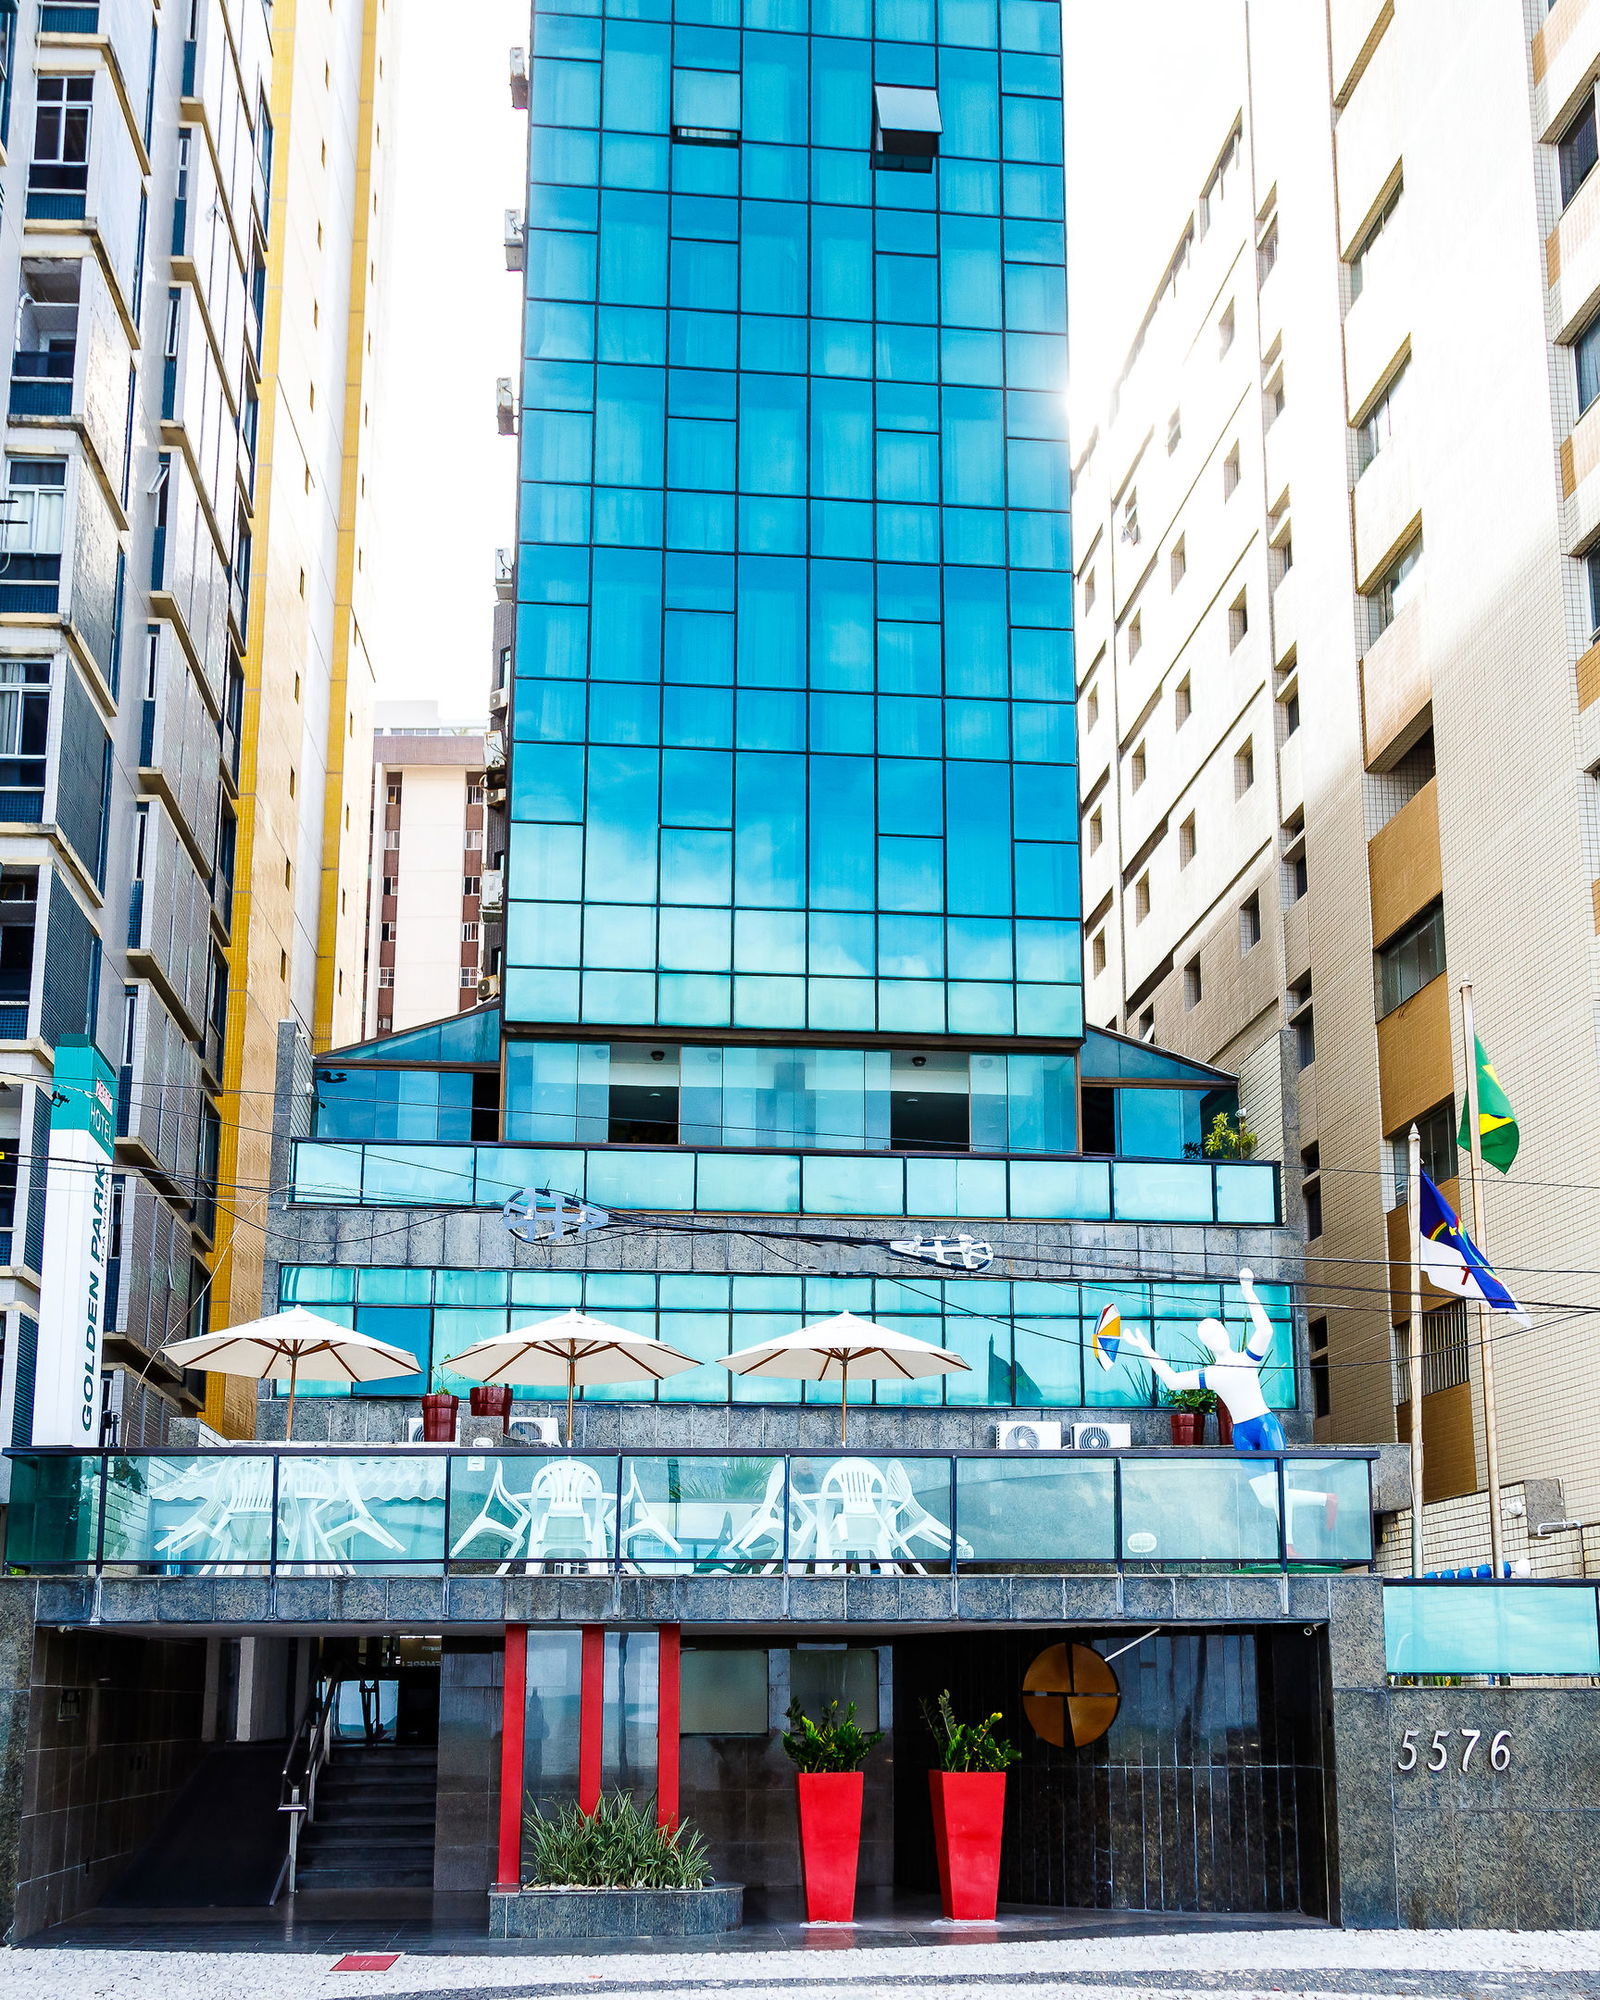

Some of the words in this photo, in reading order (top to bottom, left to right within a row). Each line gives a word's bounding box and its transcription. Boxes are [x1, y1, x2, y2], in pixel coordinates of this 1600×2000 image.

[90, 1102, 113, 1148] HOTEL
[82, 1271, 99, 1432] GOLDEN
[91, 1160, 105, 1264] PARK
[1397, 1728, 1513, 1772] 5576
